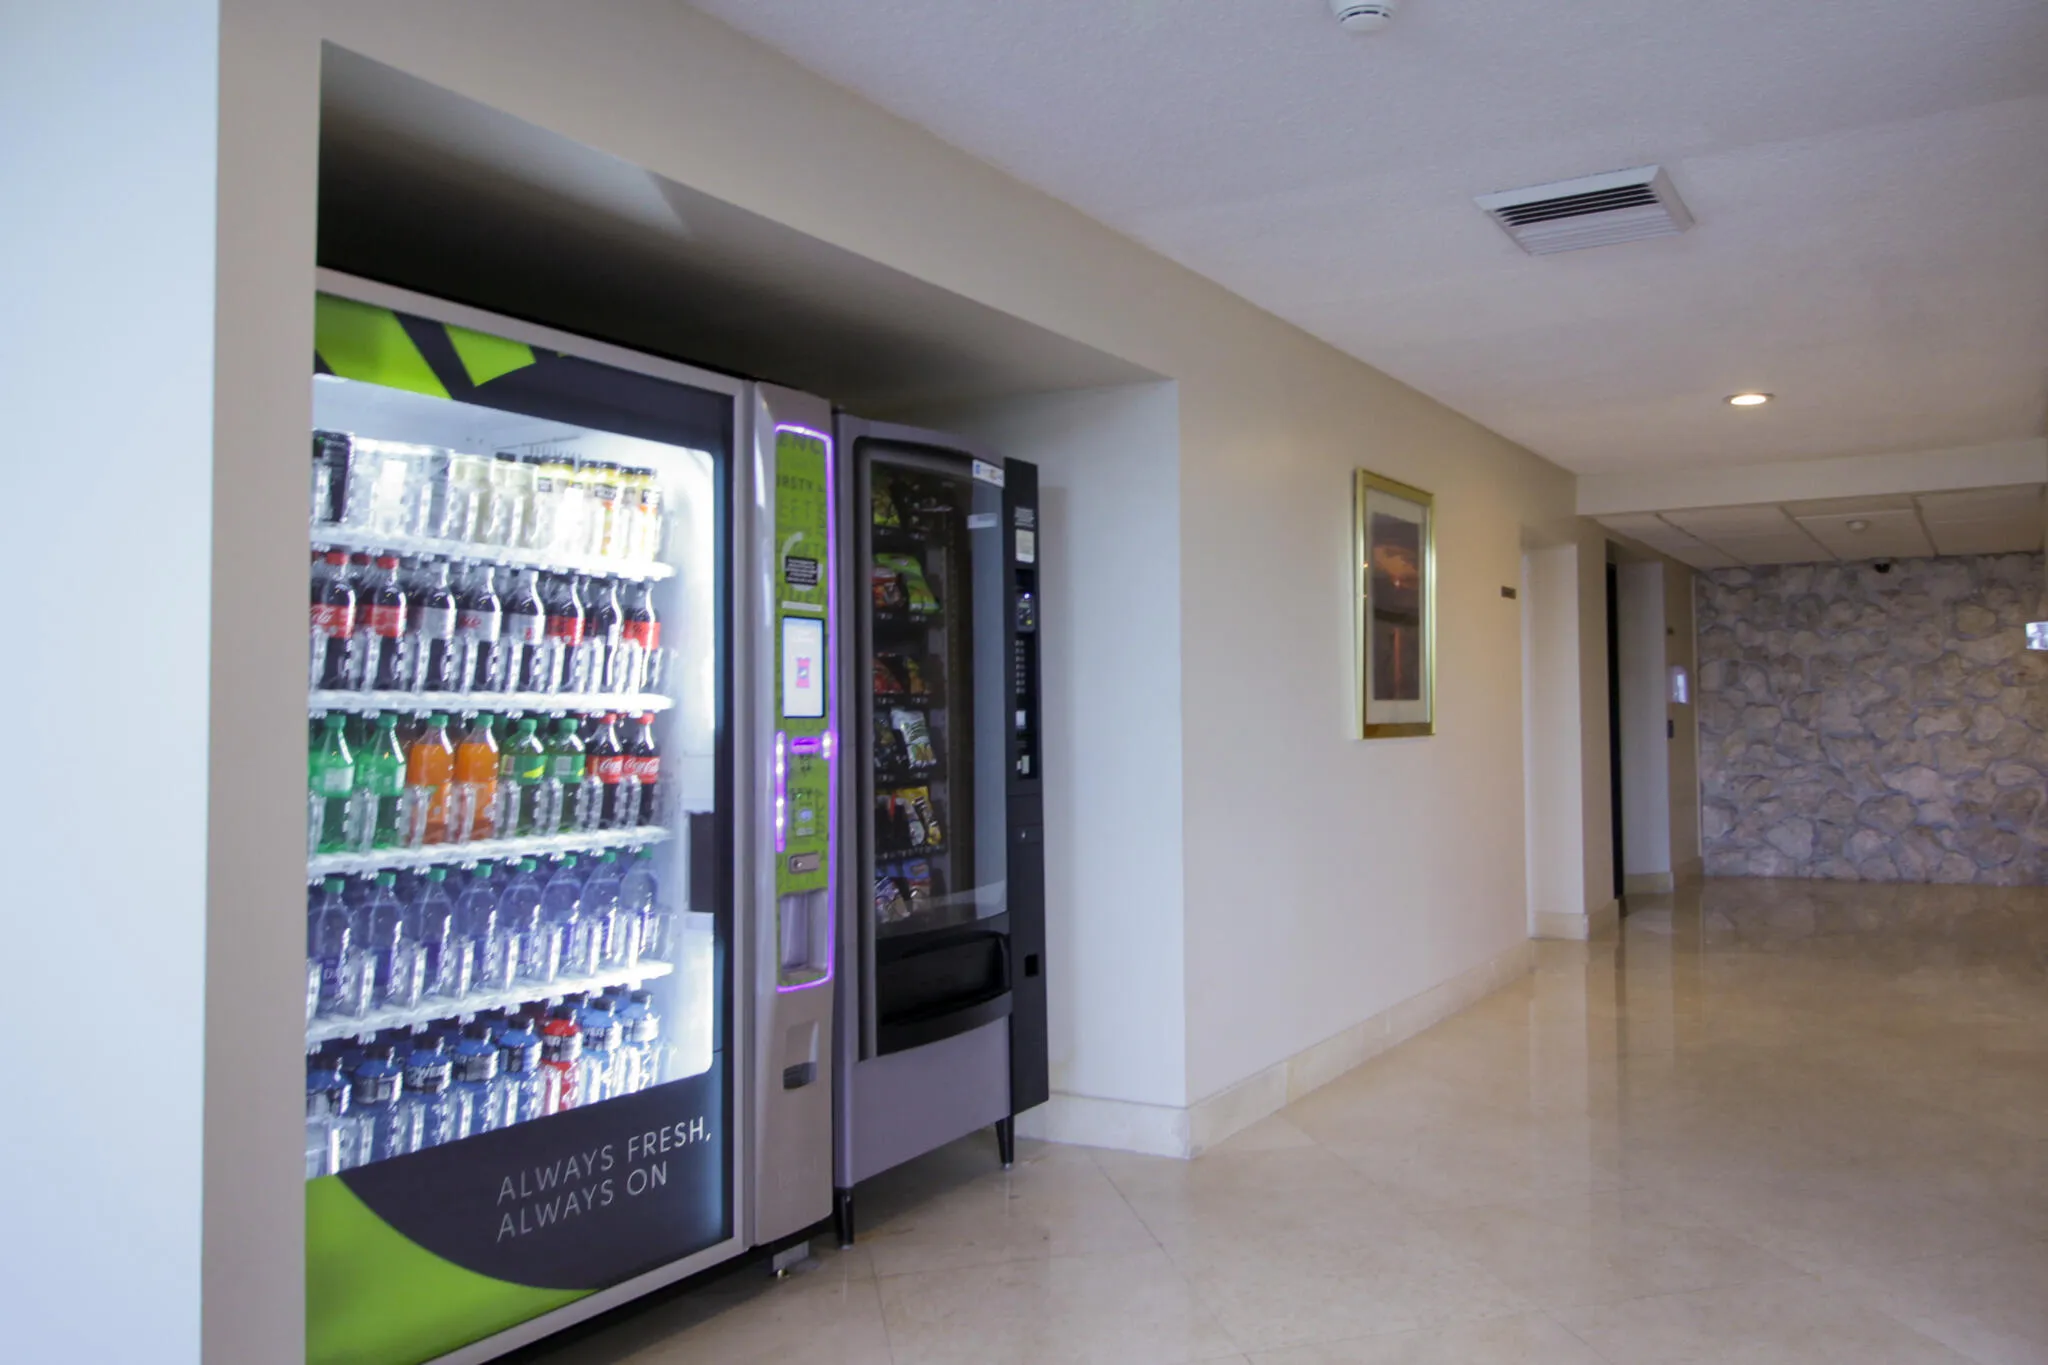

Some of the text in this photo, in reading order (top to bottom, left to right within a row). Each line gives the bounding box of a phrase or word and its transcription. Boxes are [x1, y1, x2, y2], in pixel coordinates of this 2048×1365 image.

[497, 1116, 711, 1206] ALWAYS FRESH,
[497, 1160, 667, 1243] ALWAYS ON
